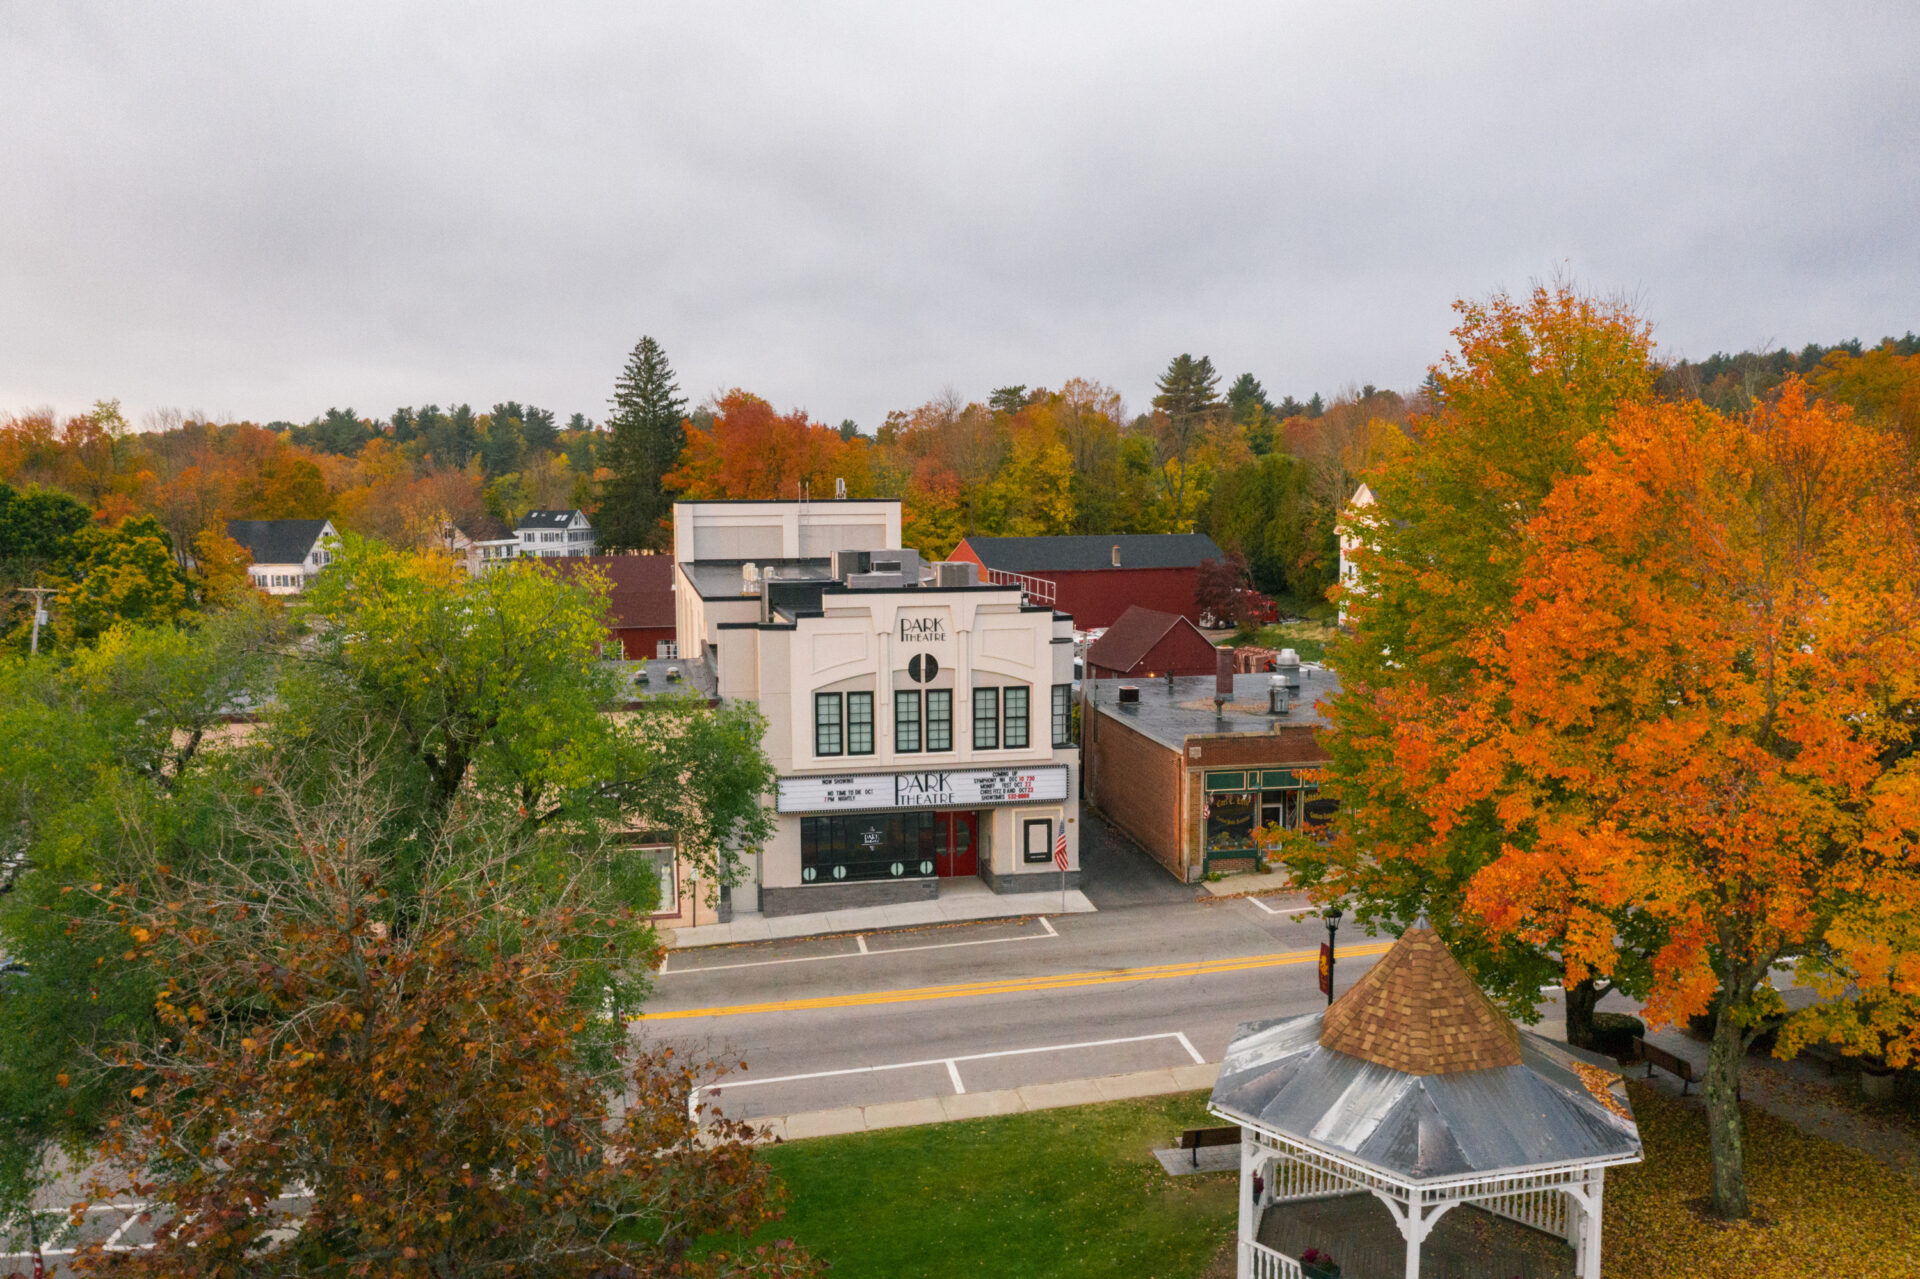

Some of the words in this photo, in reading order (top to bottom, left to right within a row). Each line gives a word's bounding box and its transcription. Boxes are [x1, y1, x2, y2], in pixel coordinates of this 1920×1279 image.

[901, 617, 944, 642] PARK
[904, 632, 947, 642] THEATRE
[895, 773, 952, 805] PARK
[900, 793, 955, 805] THEATRE
